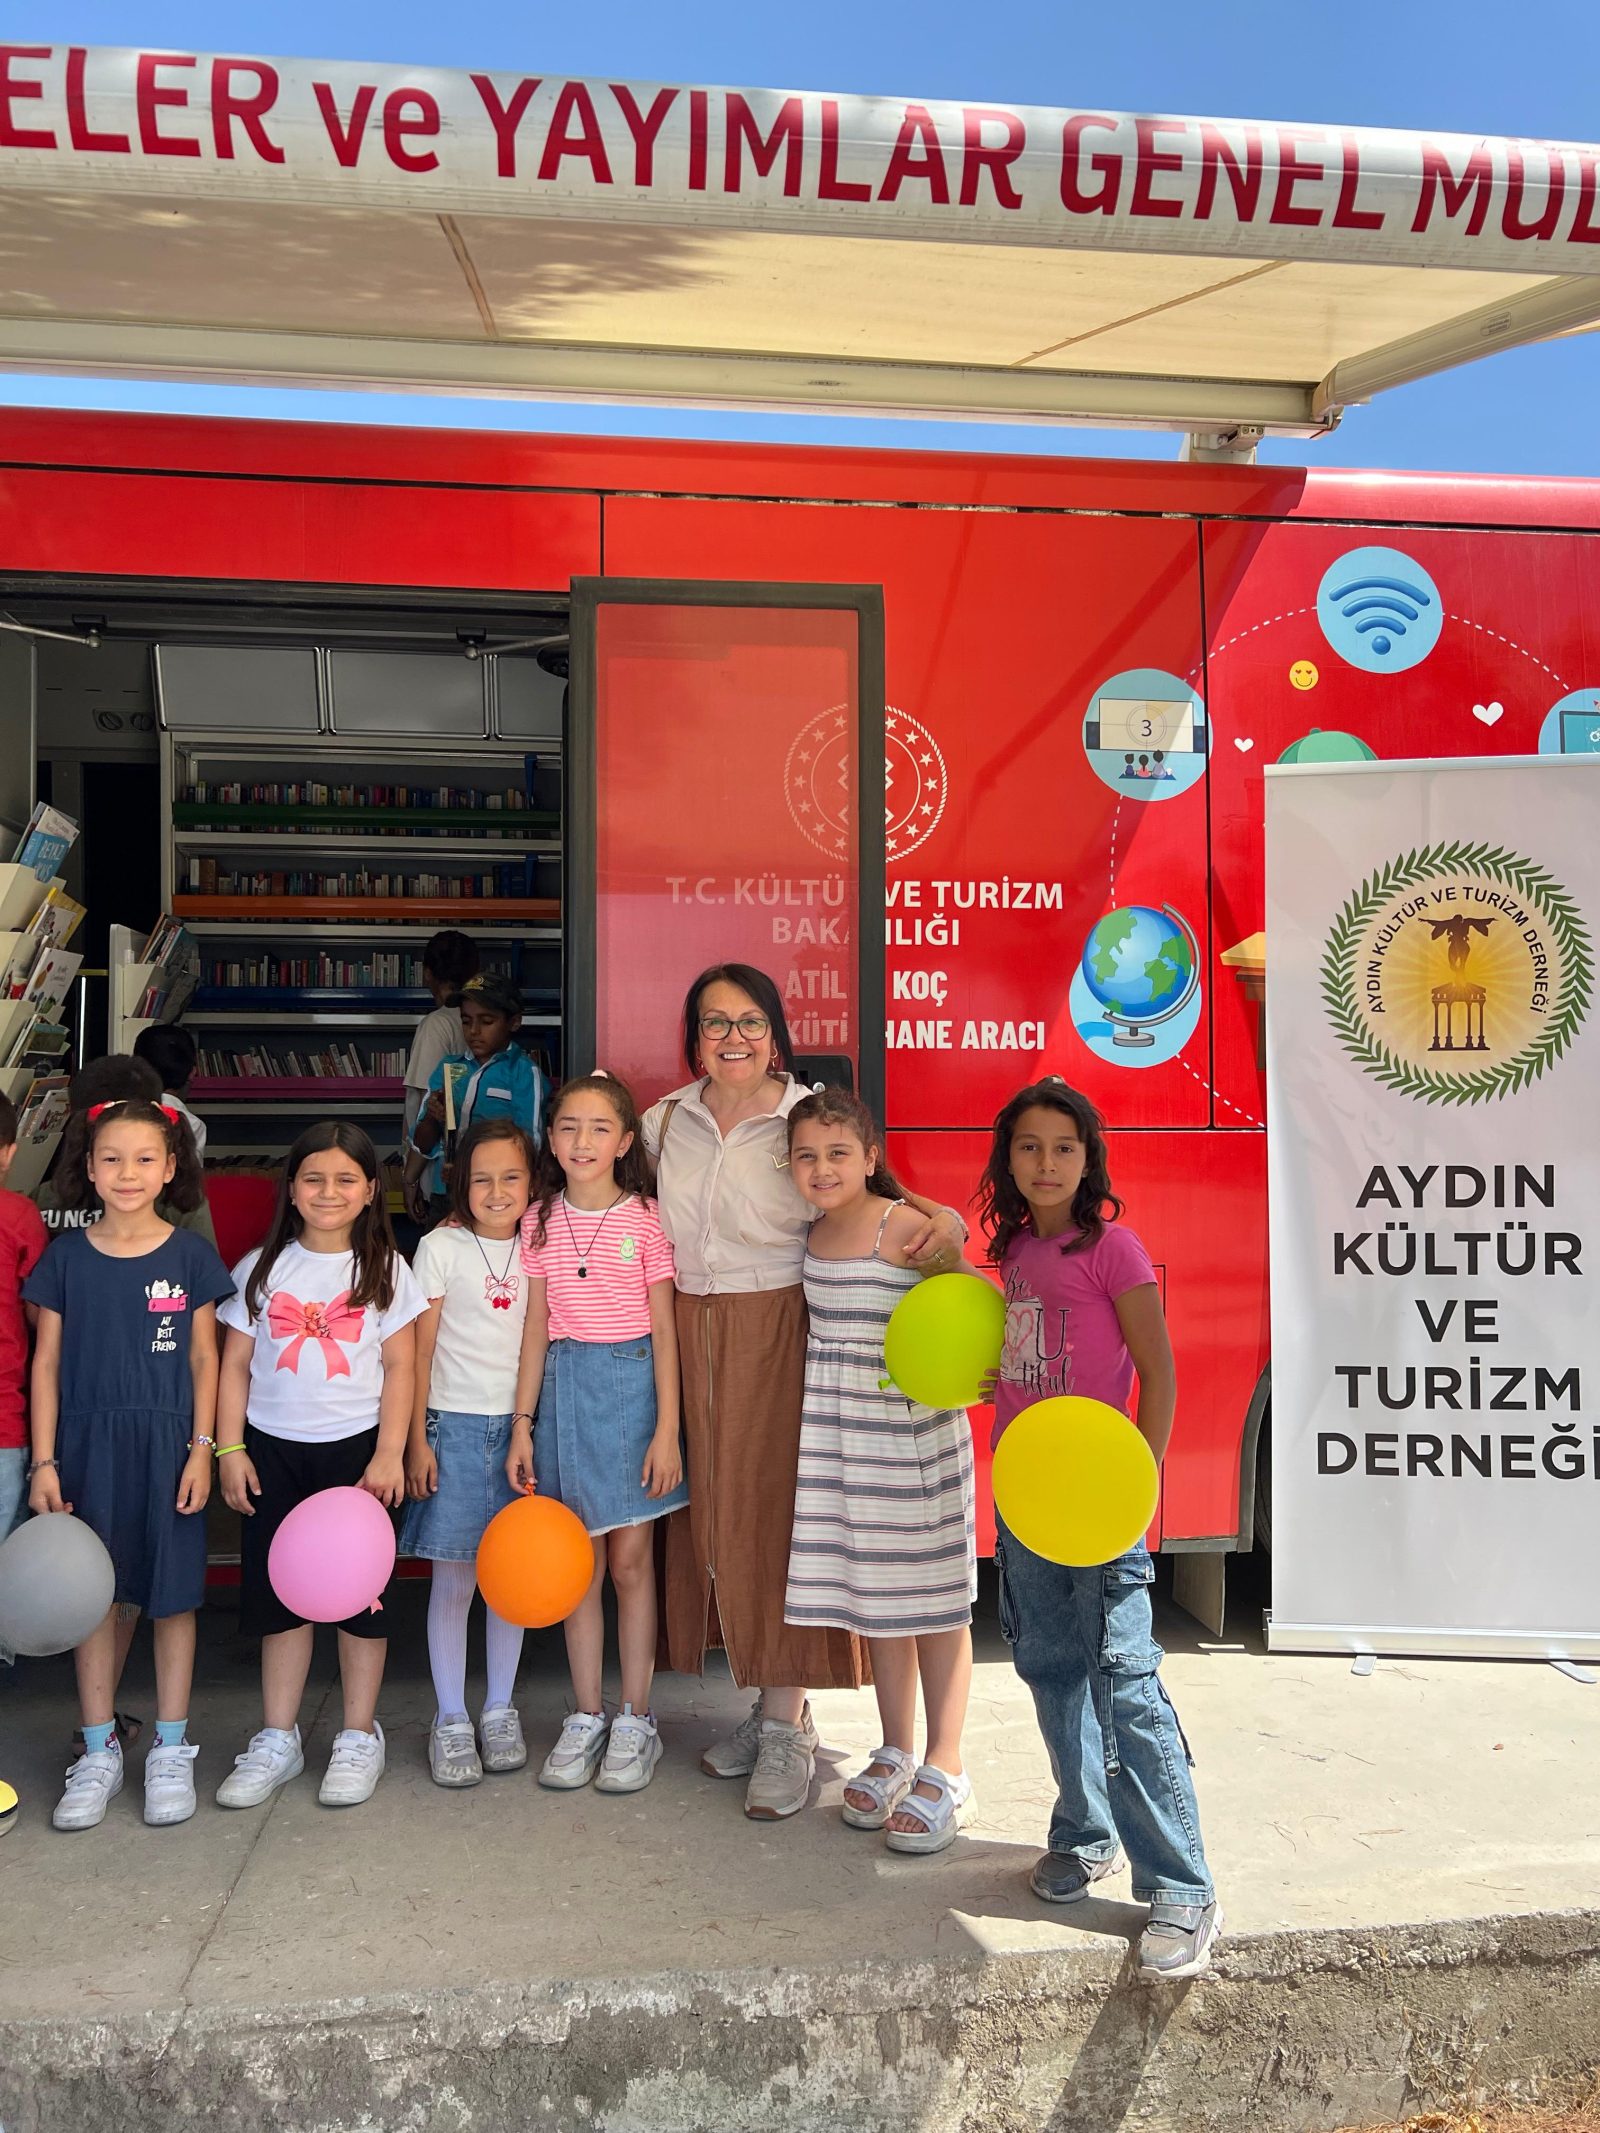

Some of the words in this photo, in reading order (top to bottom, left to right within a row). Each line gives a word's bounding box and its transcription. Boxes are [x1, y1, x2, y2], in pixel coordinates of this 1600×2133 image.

[313, 83, 440, 173] ve
[470, 74, 1023, 210] YAYIMLAR
[1059, 114, 1386, 230] GENEL
[1141, 719, 1152, 737] 3
[666, 876, 725, 905] T.C.
[734, 873, 845, 907] KÜLTÜ
[931, 876, 1063, 909] TURİZM
[1431, 886, 1458, 902] VE
[1462, 886, 1529, 928] TURİZM
[772, 912, 960, 946] BAKLIĞI
[1372, 895, 1429, 956] KÜLTÜR
[785, 963, 848, 999] ATİL
[892, 970, 948, 1007] KOÇ
[1367, 960, 1386, 1014] AYDIN
[1522, 929, 1549, 1014] DERNEĞİ
[961, 1021, 1046, 1050] ARACI
[1355, 1164, 1555, 1208] AYDIN
[1334, 1221, 1583, 1276] KÜLTÜR
[1415, 1299, 1499, 1343] VE
[1334, 1356, 1581, 1411] TURİZM
[1317, 1423, 1600, 1480] DERNEĞİ
